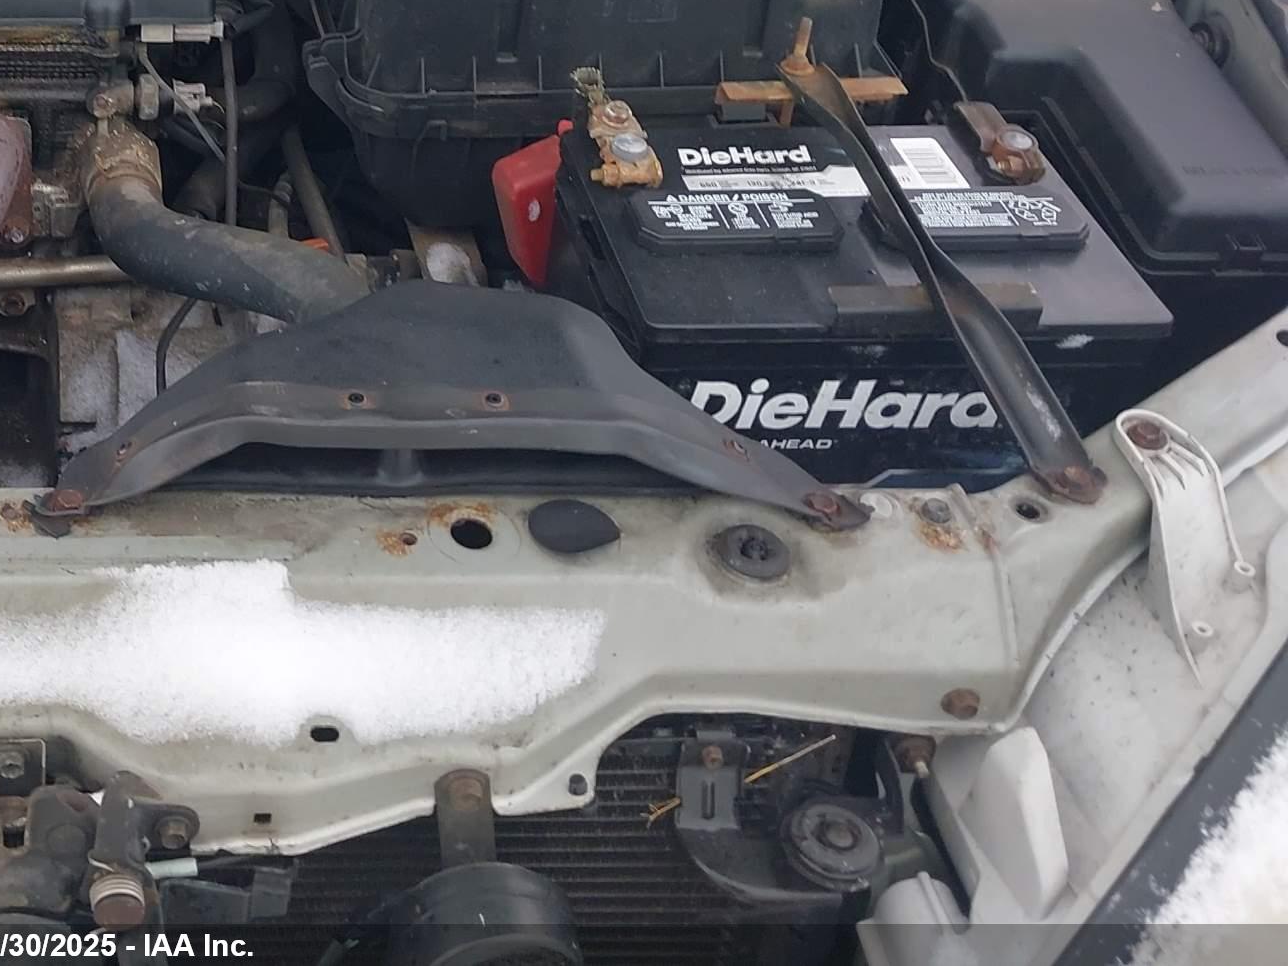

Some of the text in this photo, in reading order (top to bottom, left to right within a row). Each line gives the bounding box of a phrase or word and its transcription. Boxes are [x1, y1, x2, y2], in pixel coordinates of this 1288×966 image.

[677, 145, 813, 166] DieHard
[678, 193, 730, 202] DANGER
[742, 192, 789, 202] POISON
